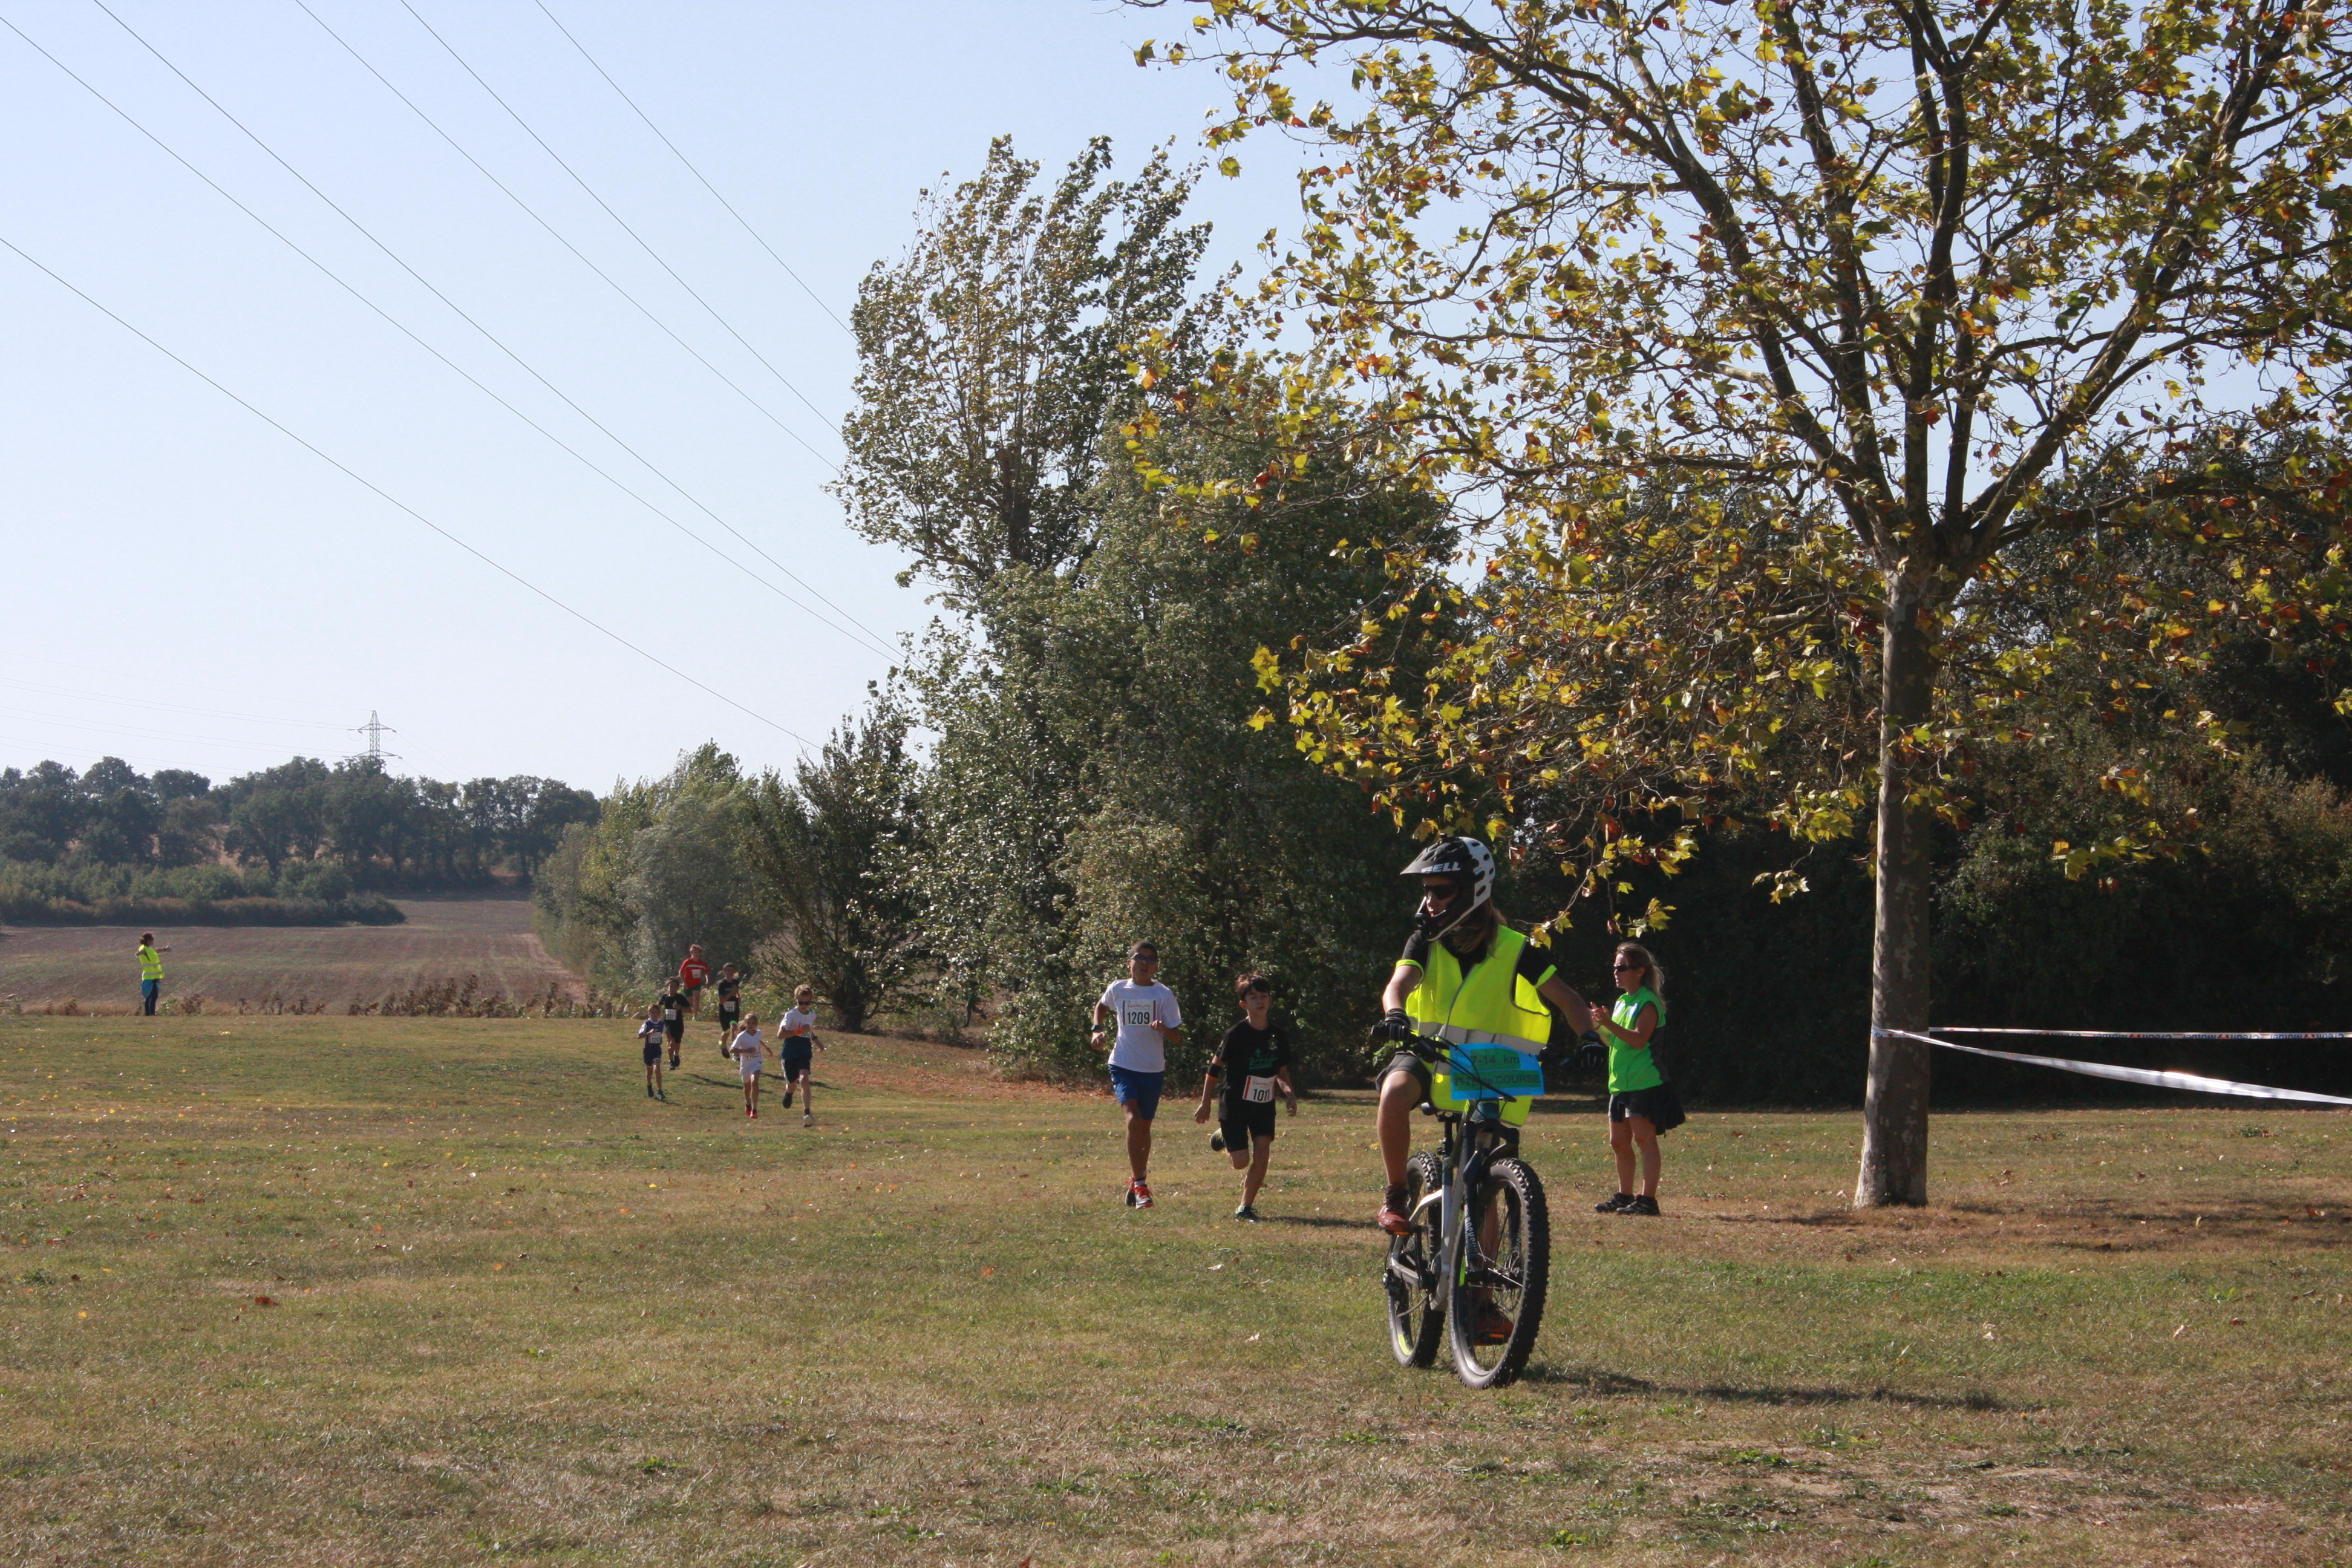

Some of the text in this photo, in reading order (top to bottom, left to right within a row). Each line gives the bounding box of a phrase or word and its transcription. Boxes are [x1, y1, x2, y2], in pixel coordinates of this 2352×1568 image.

[1421, 861, 1461, 874] BELL
[1127, 1011, 1150, 1024] 1209
[1503, 1054, 1520, 1063] km
[1496, 1074, 1540, 1084] COURSE
[1253, 1088, 1270, 1102] 1011
